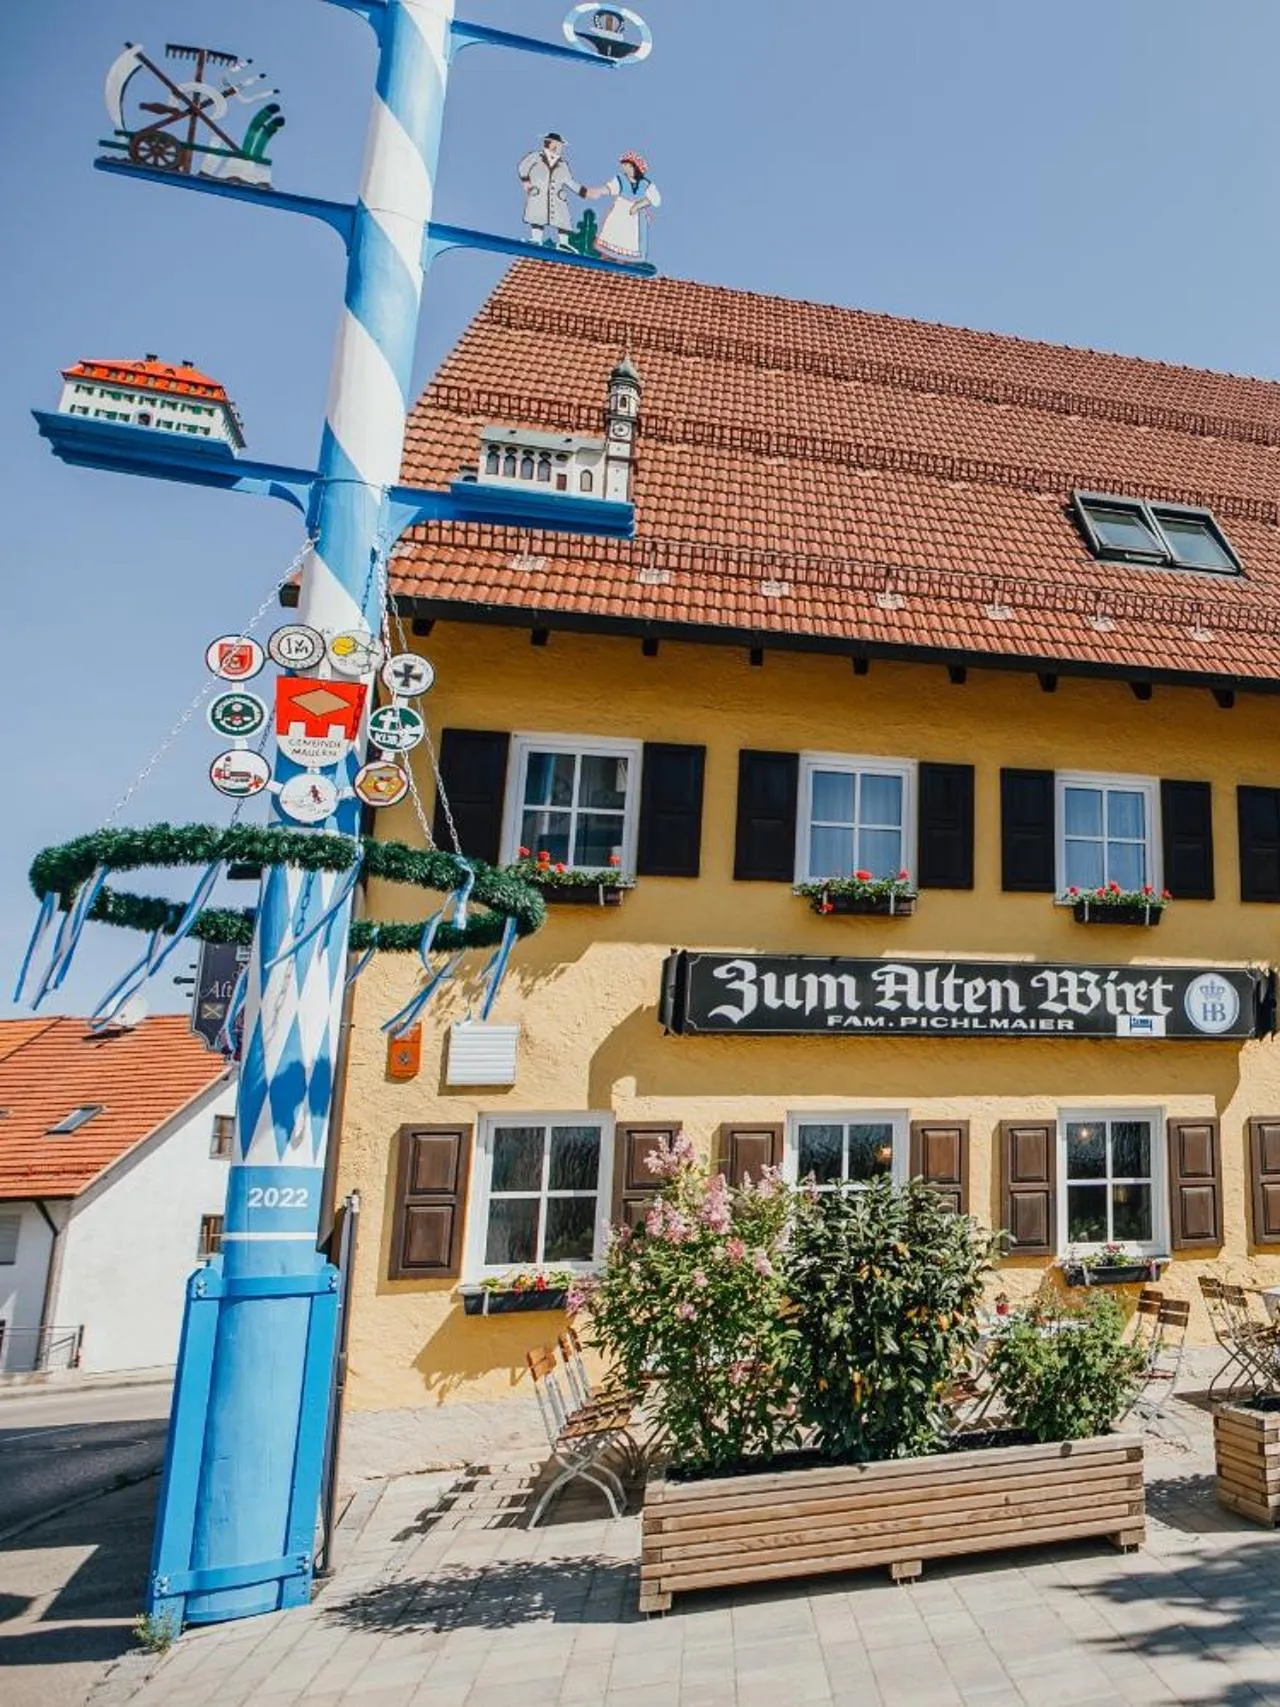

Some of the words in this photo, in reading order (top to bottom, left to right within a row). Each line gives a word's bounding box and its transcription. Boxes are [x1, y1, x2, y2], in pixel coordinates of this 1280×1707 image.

[707, 959, 861, 1024] Zum
[871, 963, 1026, 1014] Alten
[1030, 969, 1174, 1016] Wirt
[826, 1015, 895, 1027] FAM.
[900, 1016, 1075, 1031] PICHLMAIER
[247, 1187, 309, 1208] 2022
